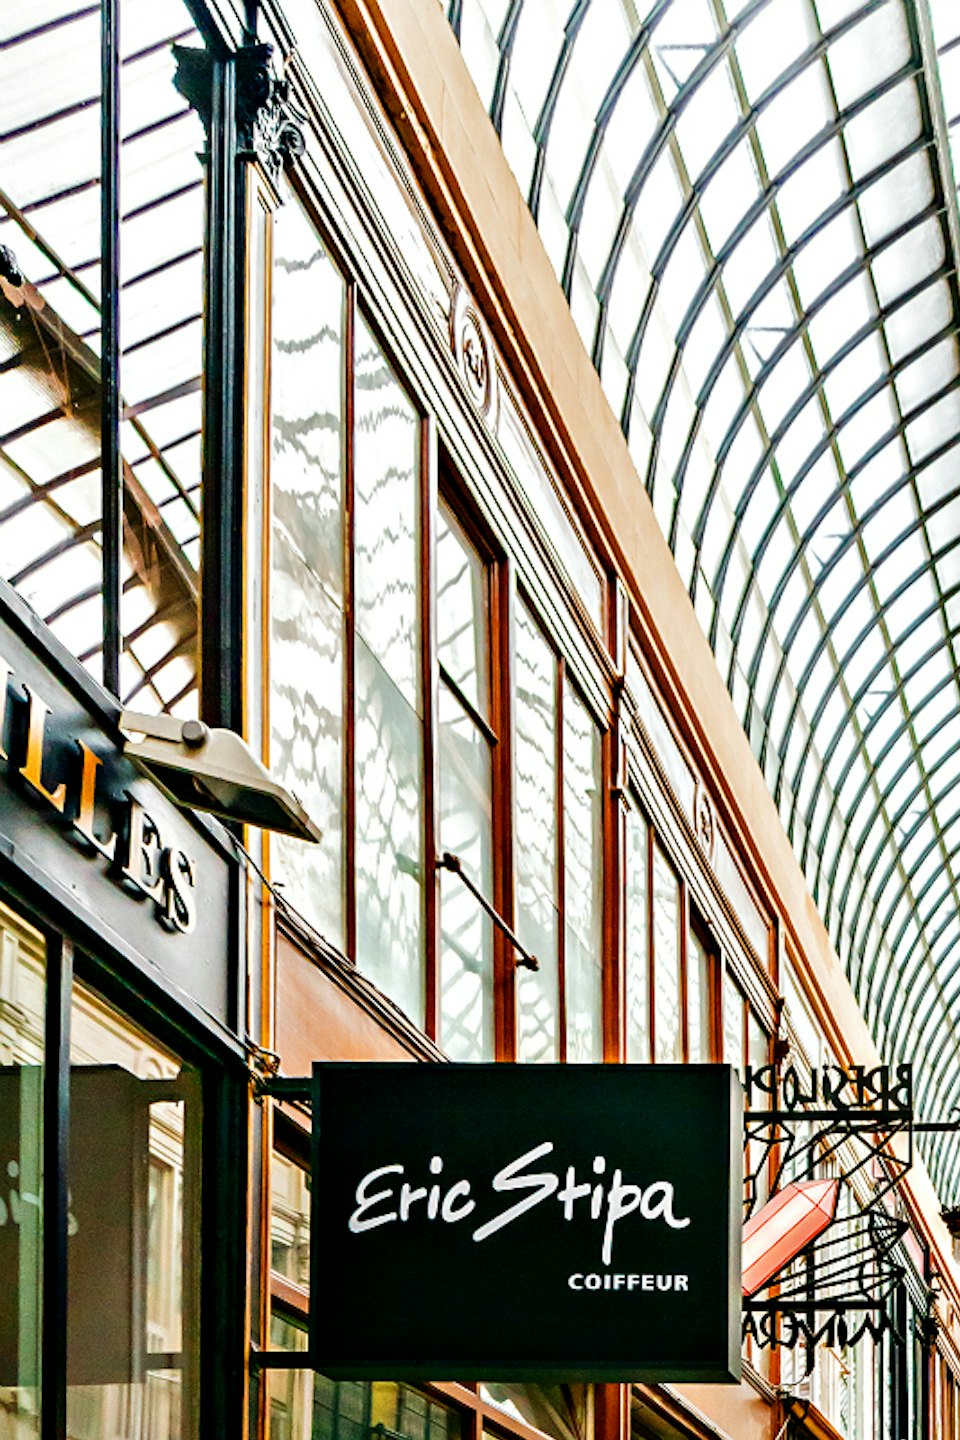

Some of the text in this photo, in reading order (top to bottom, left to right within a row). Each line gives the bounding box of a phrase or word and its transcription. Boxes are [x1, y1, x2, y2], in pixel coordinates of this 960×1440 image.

[349, 1141, 691, 1265] Eric Stipa
[568, 1273, 689, 1291] COIFFEUR
